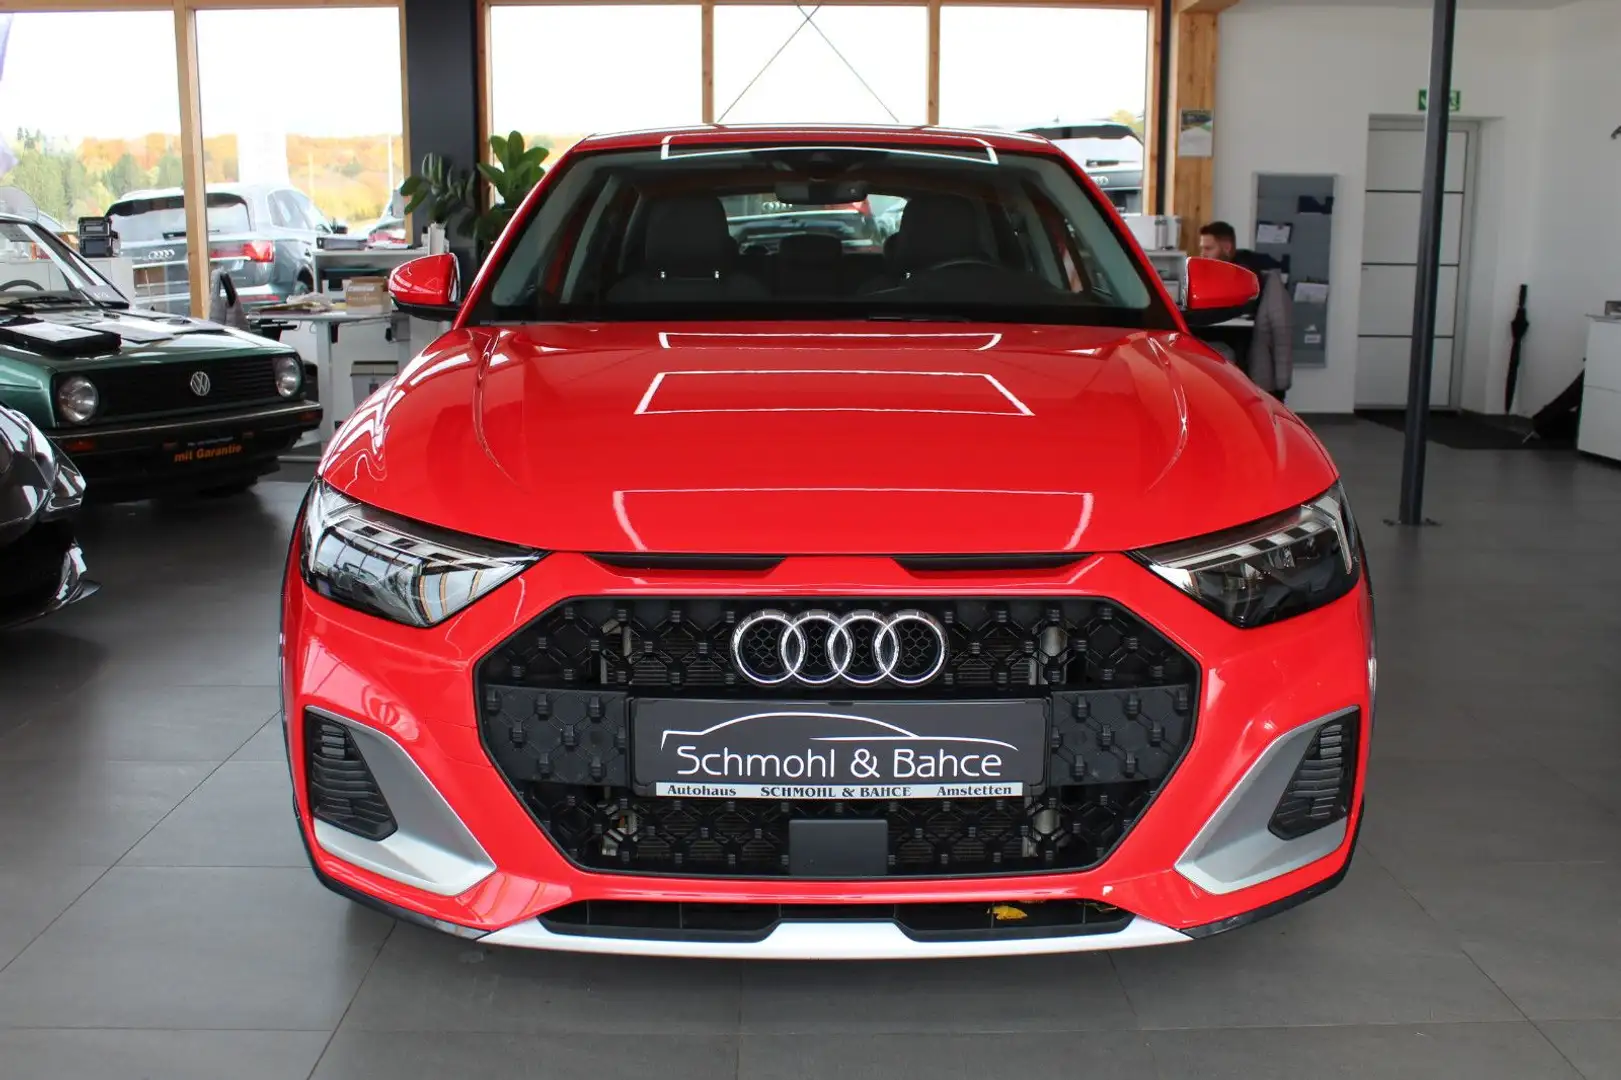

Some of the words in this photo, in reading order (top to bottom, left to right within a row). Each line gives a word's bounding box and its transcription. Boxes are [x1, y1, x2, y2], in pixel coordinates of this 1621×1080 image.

[174, 450, 193, 462] mit
[196, 444, 242, 459] Garantie
[676, 745, 835, 777] Schmohl
[850, 748, 879, 777] &
[893, 748, 1002, 777] Bahce
[667, 784, 736, 797] Autohaus
[760, 787, 834, 797] SCHMOHL
[842, 787, 855, 797] &
[859, 787, 912, 797] BAHCE
[936, 786, 1013, 796] Amstetten
